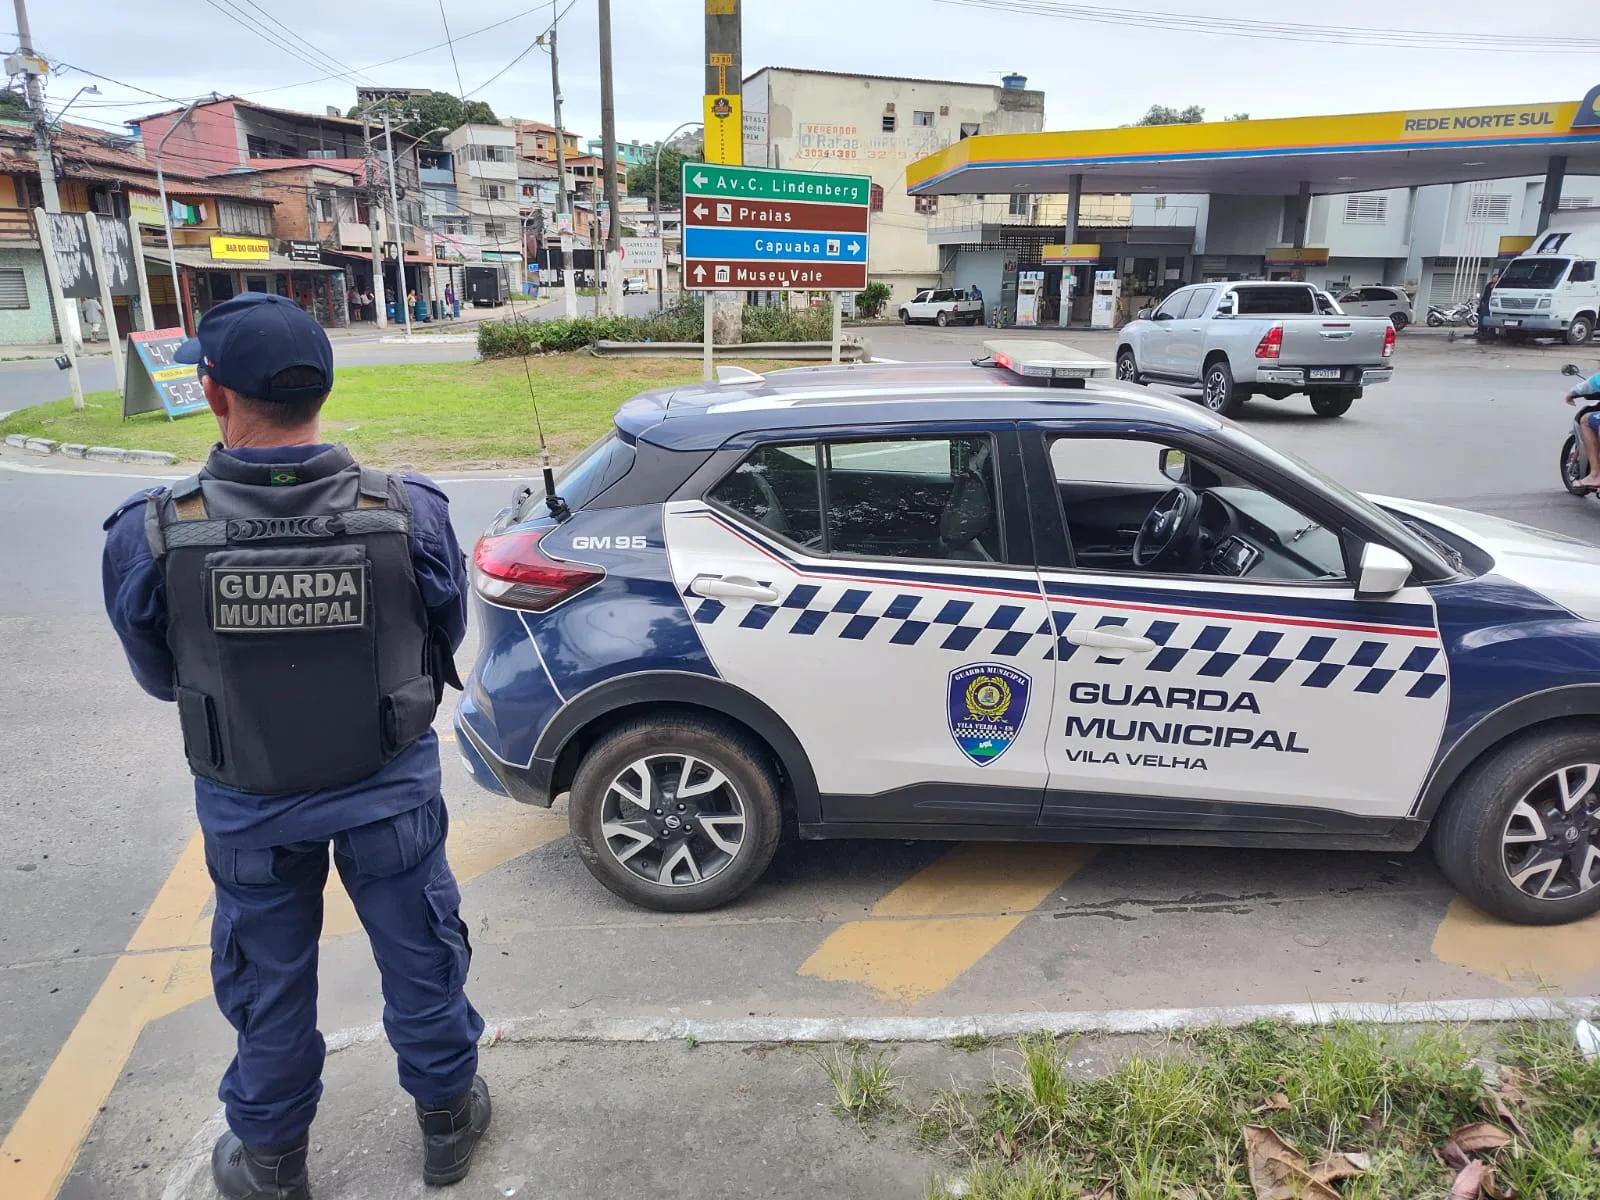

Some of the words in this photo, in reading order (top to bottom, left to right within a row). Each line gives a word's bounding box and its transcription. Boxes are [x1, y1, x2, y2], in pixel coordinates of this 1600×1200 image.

[1404, 117, 1450, 131] REDE
[1453, 113, 1516, 129] NORTE
[1518, 111, 1554, 126] SUL
[772, 179, 858, 199] Lindenberg
[740, 207, 792, 222] Praias
[226, 243, 236, 252] BAR
[237, 244, 246, 253] DO
[755, 239, 820, 254] Capuaba
[737, 268, 785, 281] Museu
[790, 269, 823, 282] Vale
[572, 536, 611, 550] GM
[615, 535, 647, 549] 95
[219, 571, 358, 600] GUARDA
[220, 601, 358, 626] MUNICIPAL
[954, 667, 985, 681] GUARDA
[986, 667, 1025, 686] MUNICIPAL
[1068, 681, 1261, 715] GUARDA
[975, 723, 997, 731] VELHA
[1064, 715, 1310, 754] MUNICIPAL
[1065, 749, 1120, 765] VILA
[1126, 753, 1208, 771] VELHA
